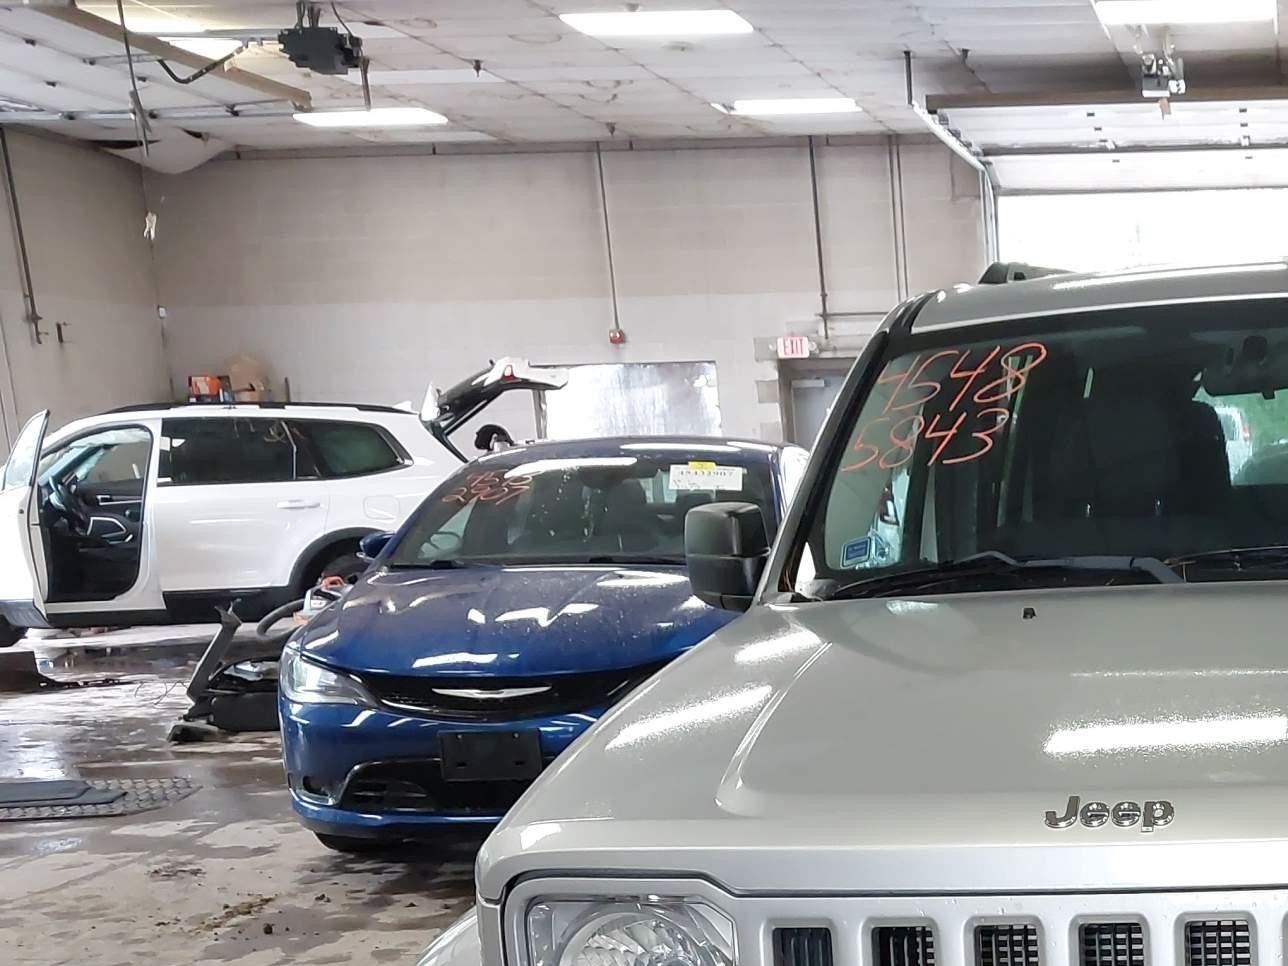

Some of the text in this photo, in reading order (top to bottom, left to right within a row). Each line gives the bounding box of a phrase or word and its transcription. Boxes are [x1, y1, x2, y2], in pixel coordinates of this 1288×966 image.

[783, 338, 804, 355] EXIT
[878, 343, 1047, 414] 4548
[840, 407, 1010, 472] 5843
[1045, 796, 1174, 833] Jeep
